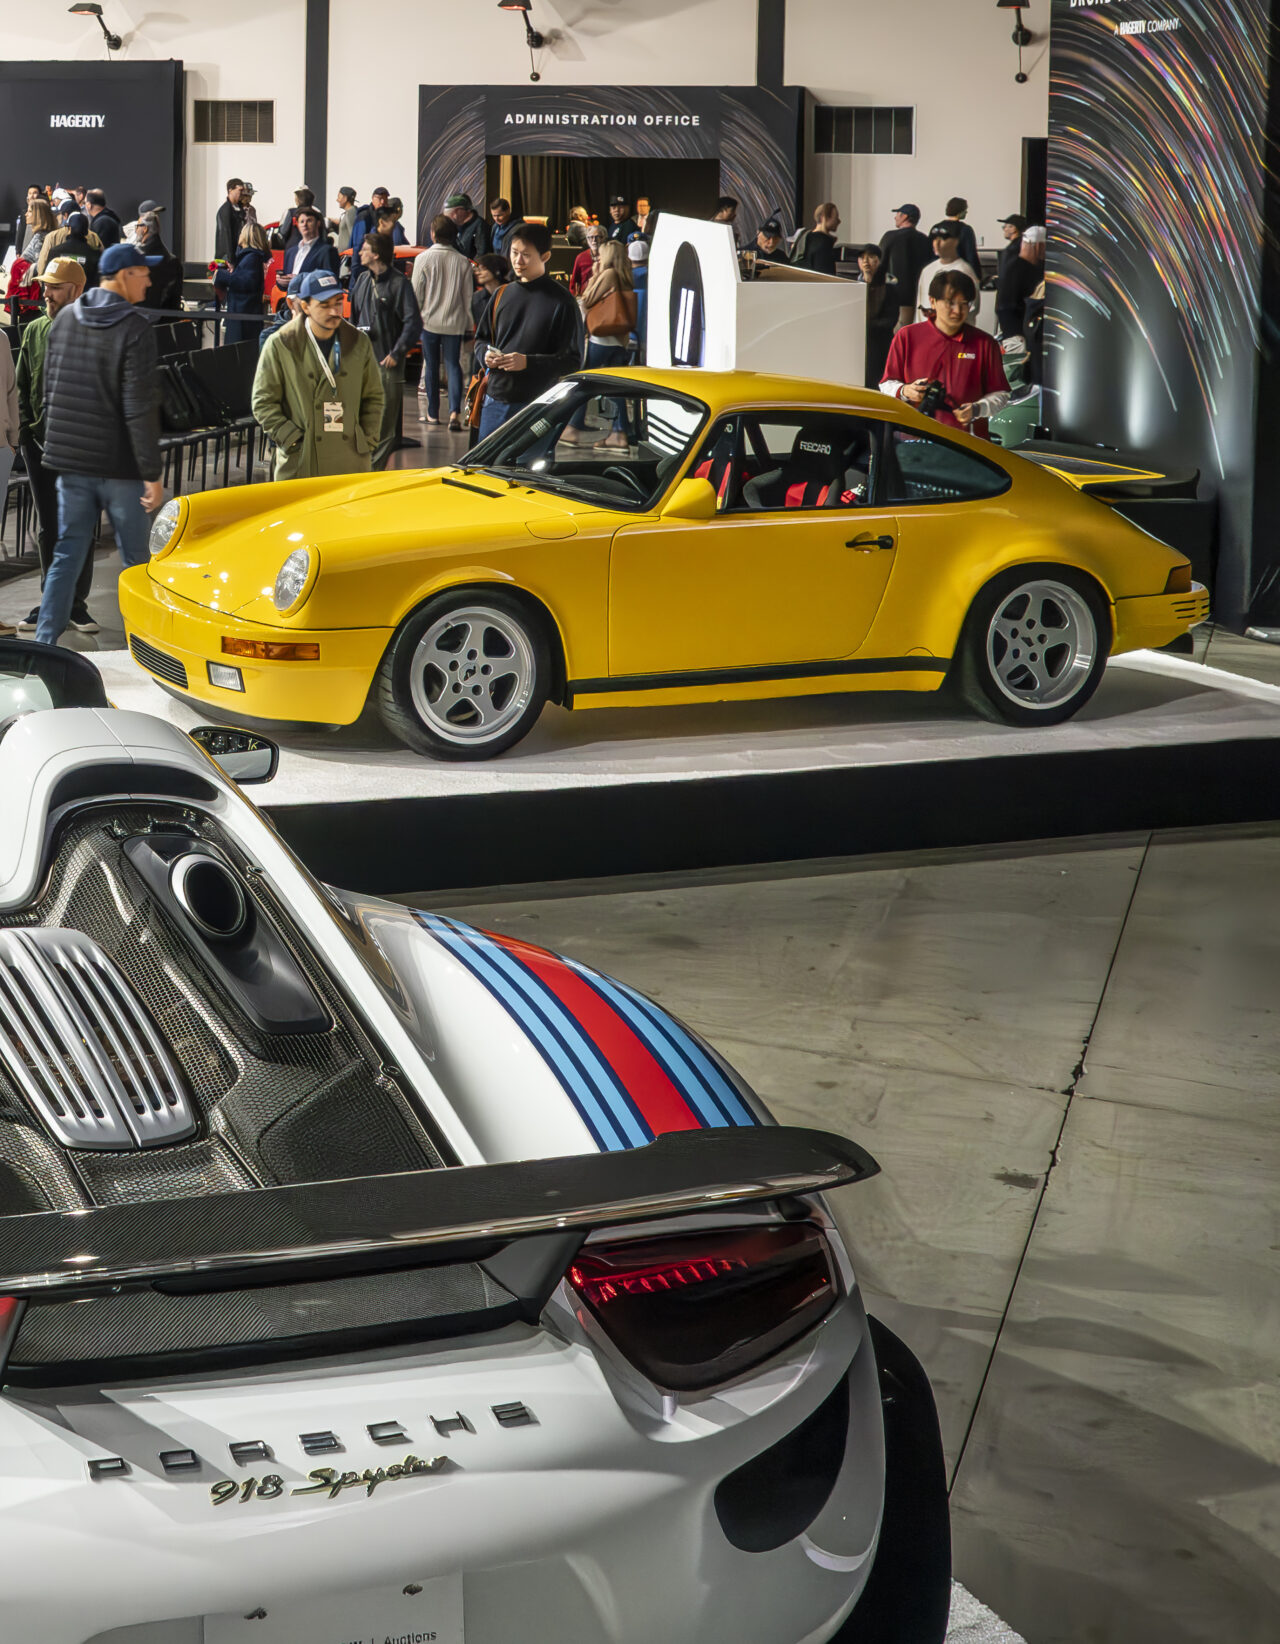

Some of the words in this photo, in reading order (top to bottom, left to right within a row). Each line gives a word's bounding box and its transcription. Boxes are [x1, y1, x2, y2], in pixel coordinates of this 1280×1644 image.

[1114, 24, 1119, 36] A
[1120, 20, 1146, 35] HAGERTY
[1147, 18, 1180, 33] COMPANY
[50, 114, 105, 128] HAGERTY
[504, 113, 637, 125] ADMINISTRATION
[643, 115, 700, 126] OFFICE
[800, 441, 831, 455] RECARO
[87, 1401, 535, 1482] PORSCHE
[209, 1474, 283, 1506] 918
[291, 1454, 450, 1498] Spyder
